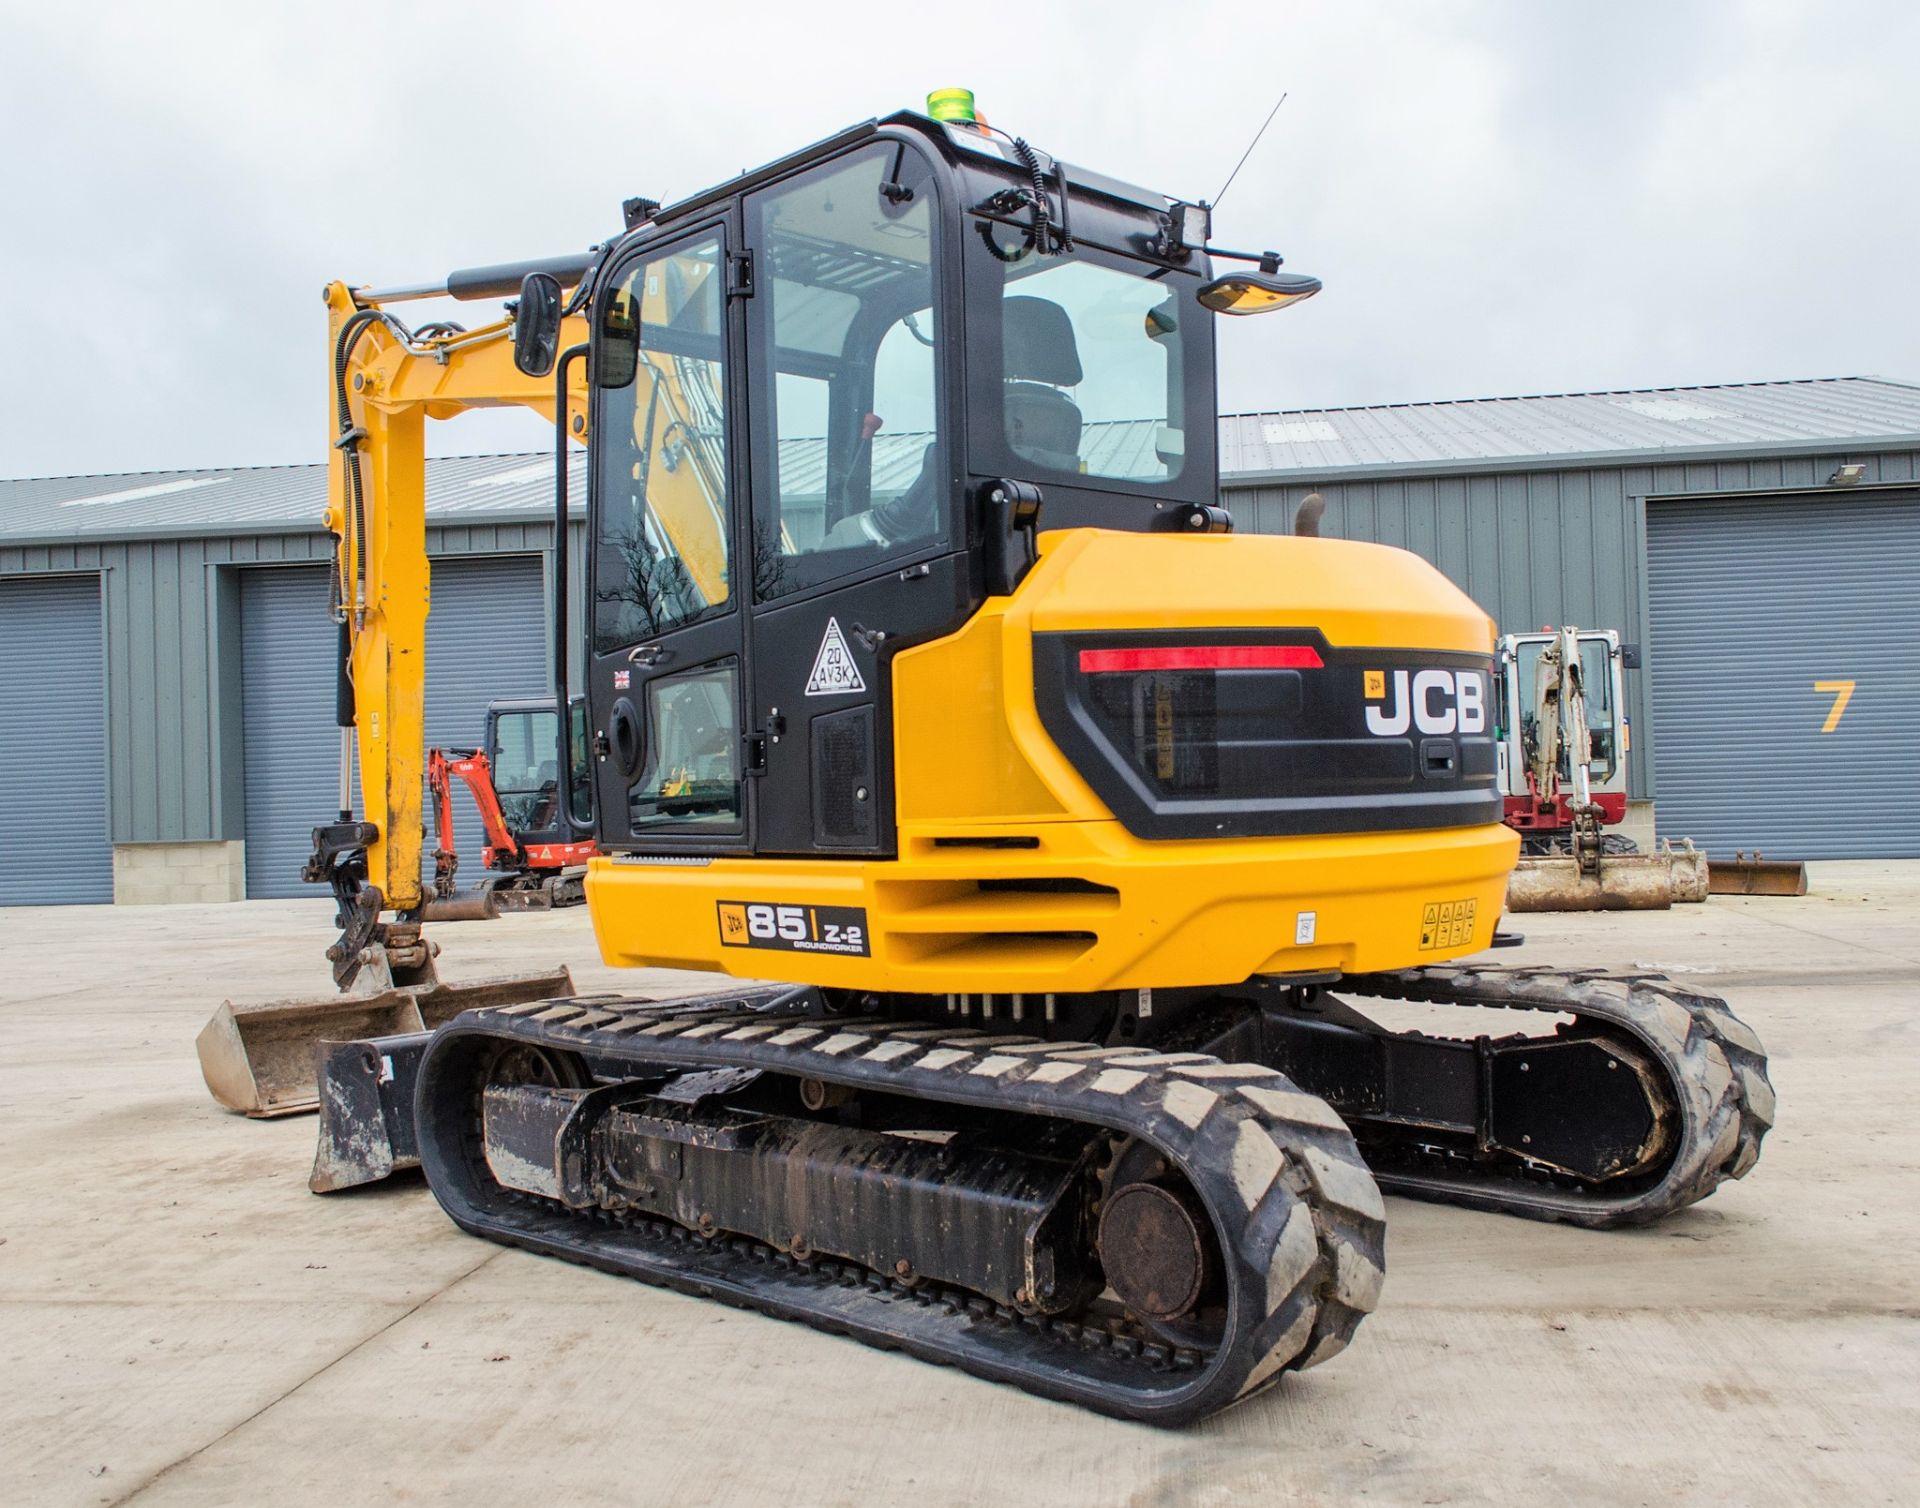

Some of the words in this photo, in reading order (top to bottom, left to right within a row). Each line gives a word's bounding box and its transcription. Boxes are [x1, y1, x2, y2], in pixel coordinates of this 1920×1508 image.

[827, 647, 841, 665] 20
[1365, 670, 1485, 736] JCB
[1814, 680, 1856, 733] 7
[747, 905, 807, 940] 85
[824, 924, 863, 944] Z-2
[793, 940, 863, 953] GROUNDWORKER
